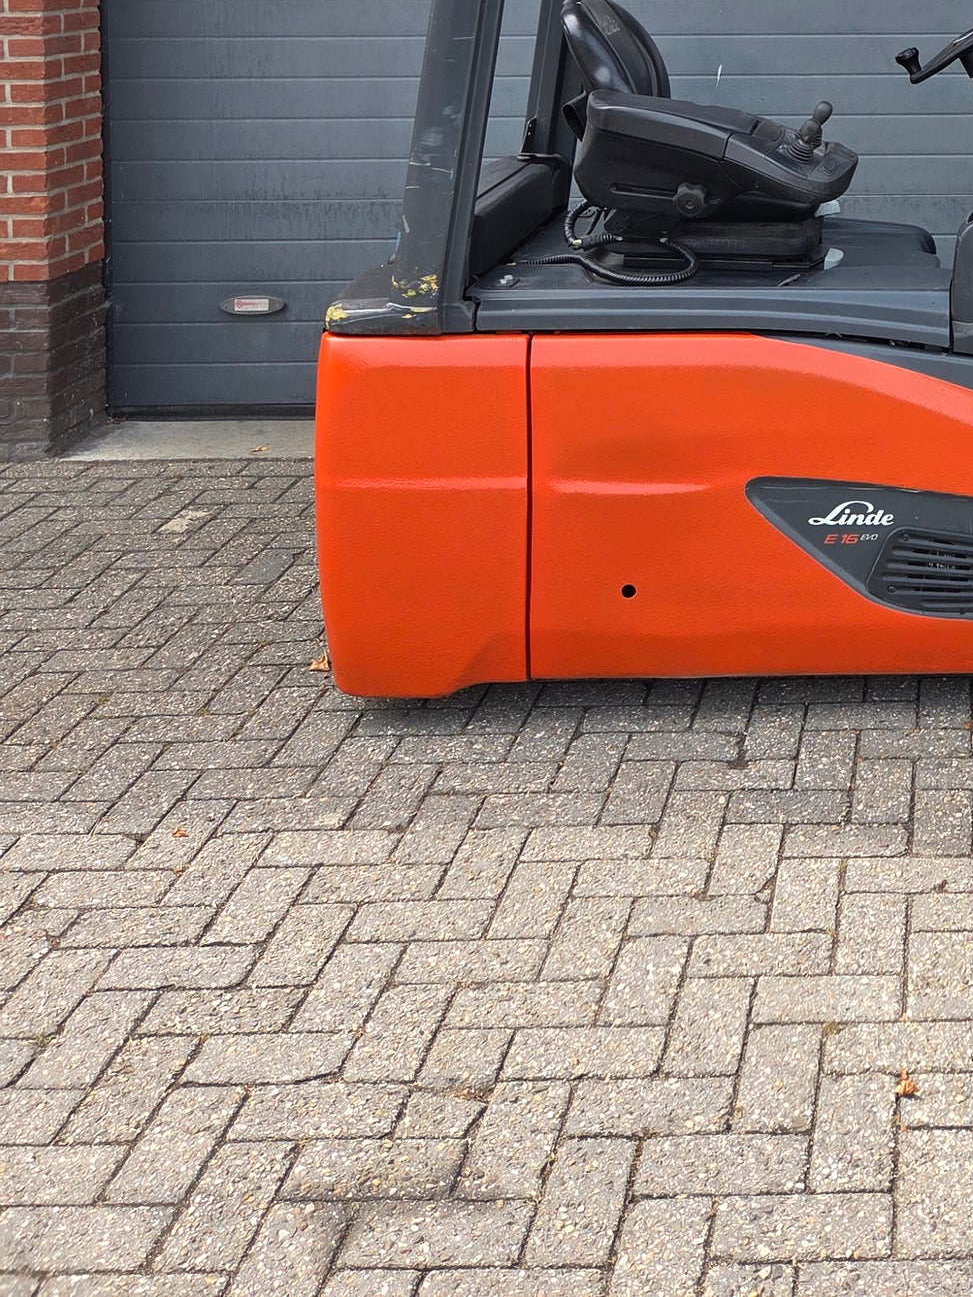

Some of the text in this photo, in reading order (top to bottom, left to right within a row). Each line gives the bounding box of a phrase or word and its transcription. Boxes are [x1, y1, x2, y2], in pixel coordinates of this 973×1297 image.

[807, 500, 894, 526] Linde
[823, 534, 838, 544] E
[841, 534, 859, 544] 16
